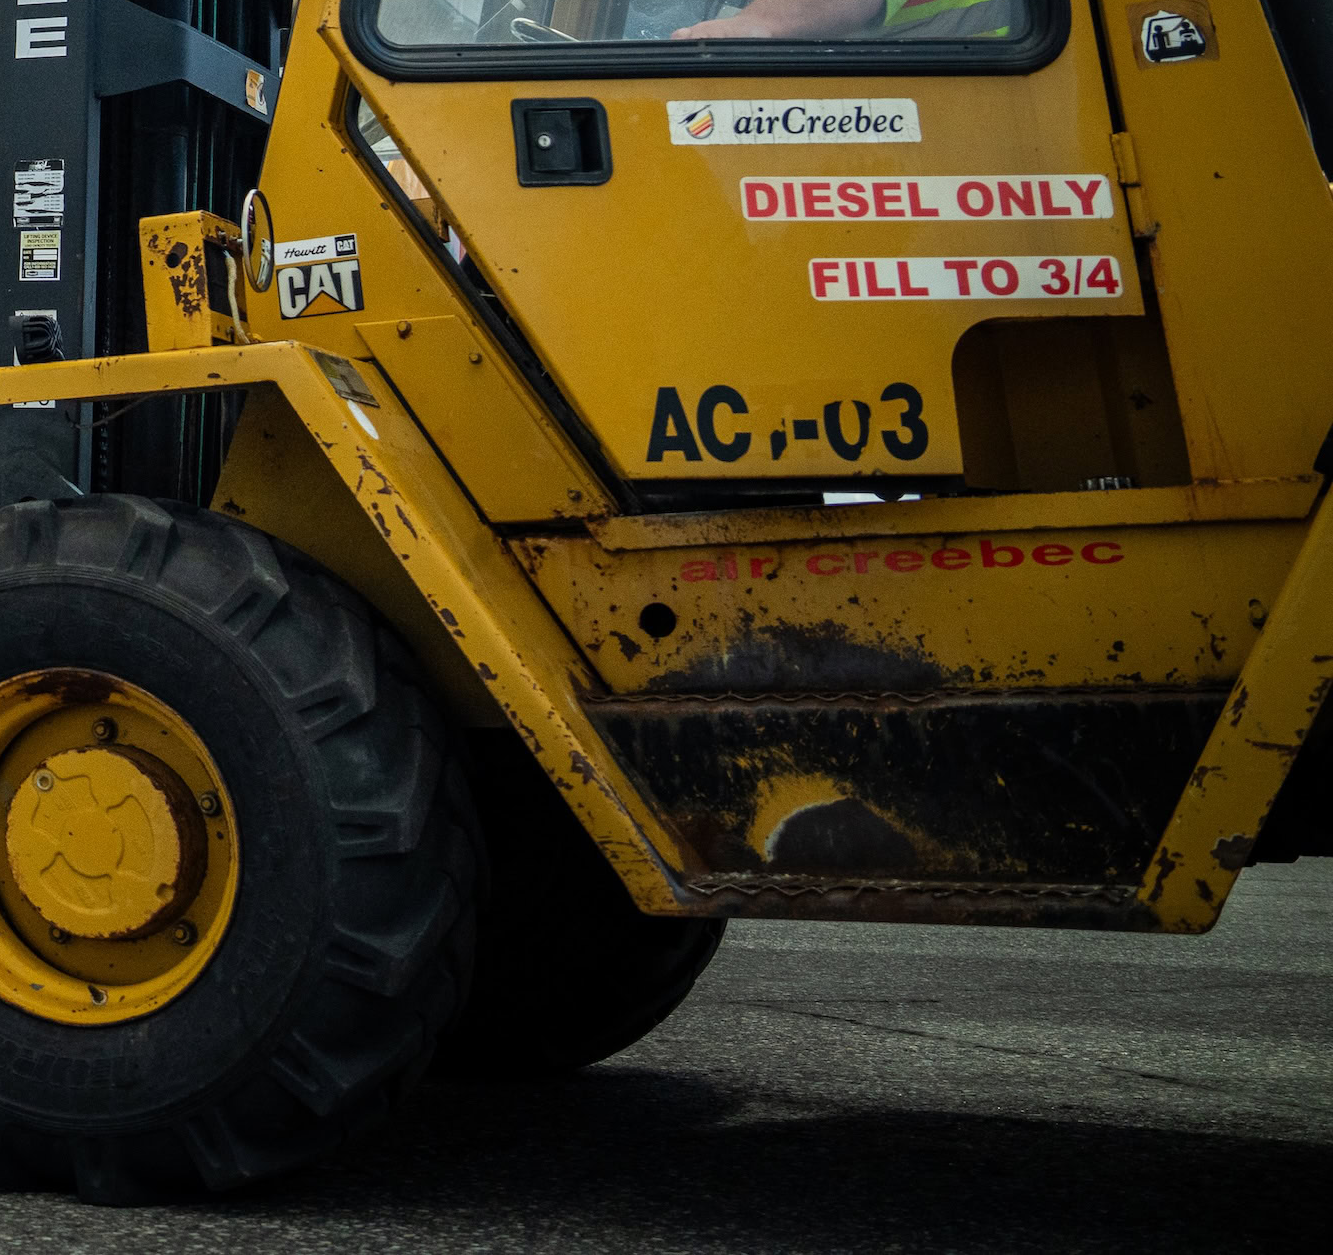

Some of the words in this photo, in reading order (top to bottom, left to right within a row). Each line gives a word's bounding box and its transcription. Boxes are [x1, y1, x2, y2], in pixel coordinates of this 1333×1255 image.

[733, 105, 904, 136] airCreebec
[744, 180, 939, 219] DIESEL
[957, 178, 1102, 217] ONLY
[284, 244, 327, 259] Hewitt
[336, 239, 355, 252] CAT
[277, 259, 359, 318] CAT
[812, 260, 930, 298] FILL
[944, 259, 1020, 296] TO
[1039, 257, 1119, 295] 3/4
[679, 551, 781, 583] air
[807, 540, 1126, 576] creebec
